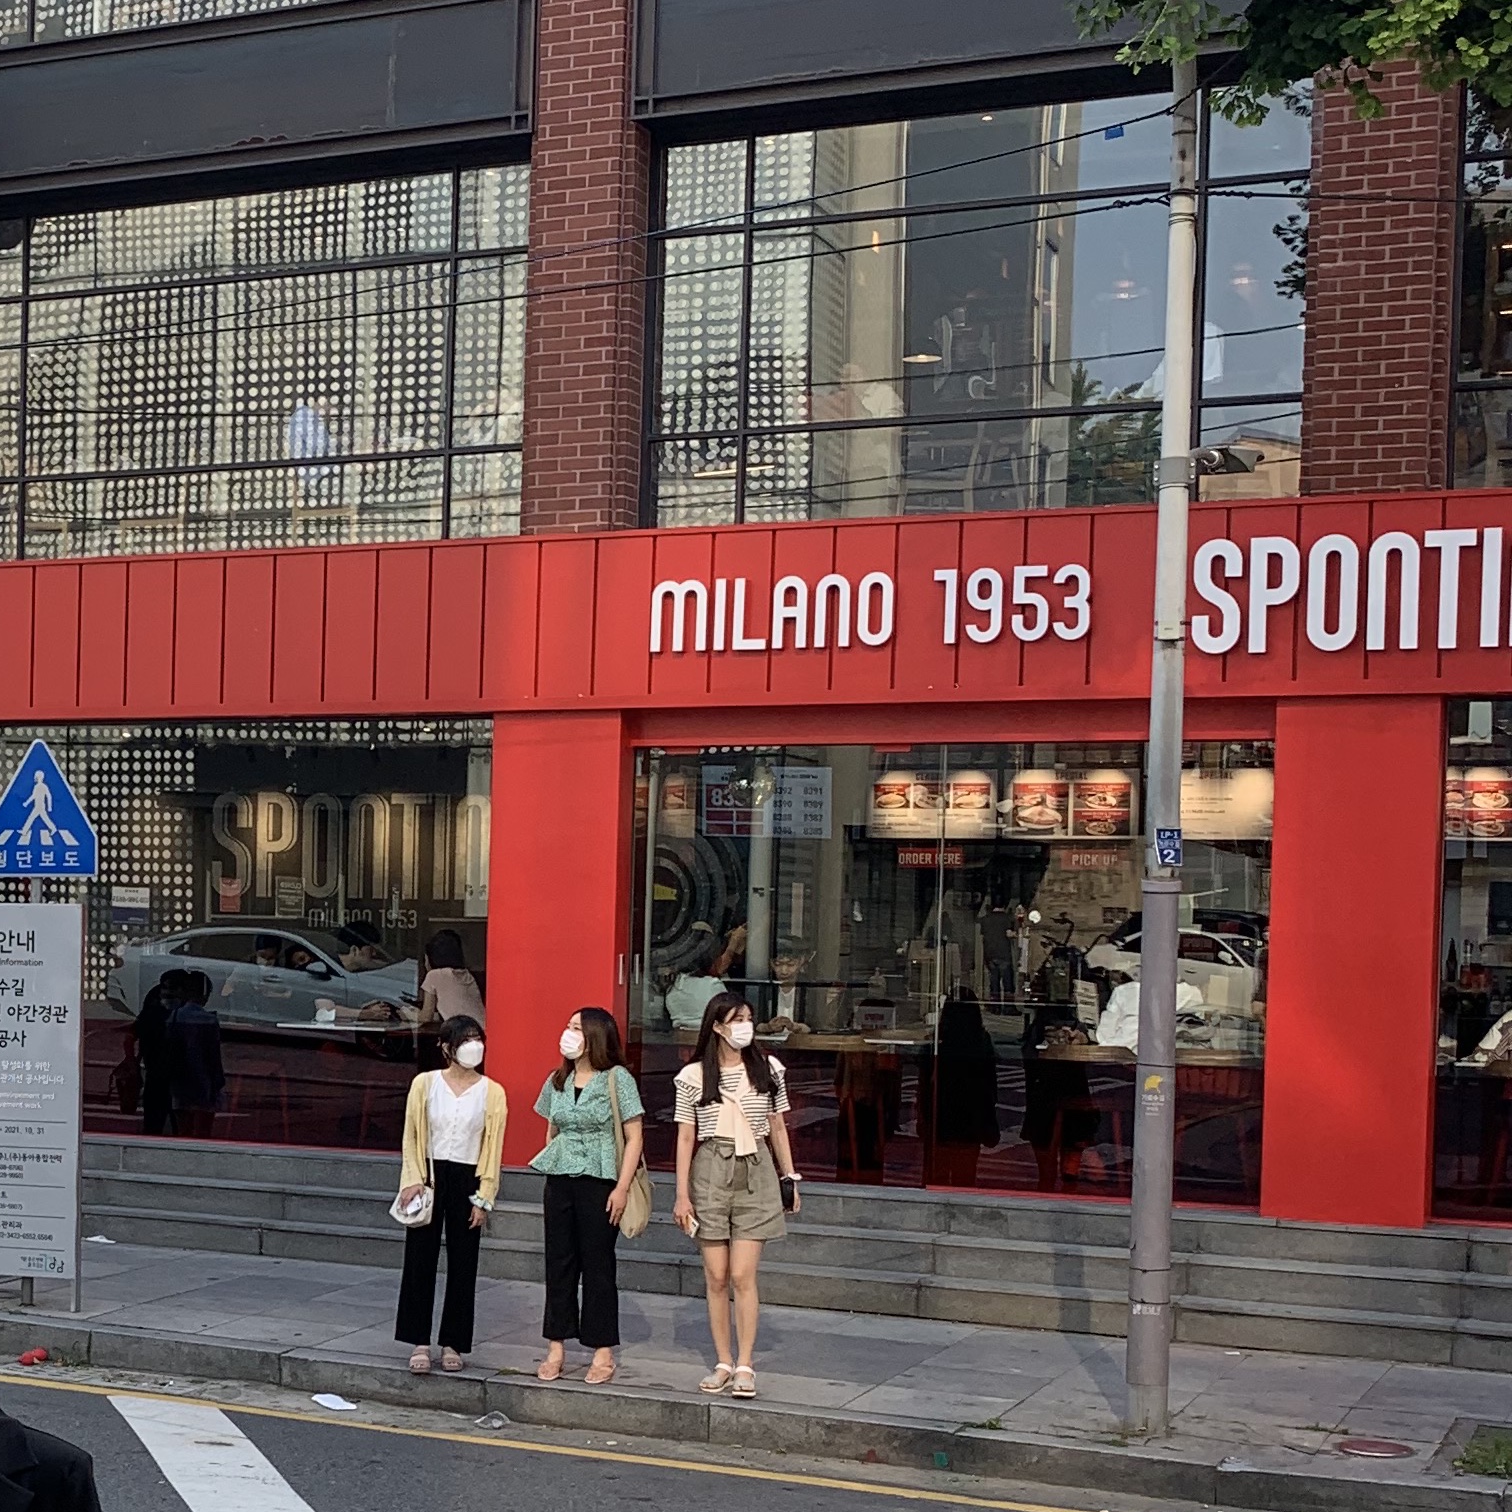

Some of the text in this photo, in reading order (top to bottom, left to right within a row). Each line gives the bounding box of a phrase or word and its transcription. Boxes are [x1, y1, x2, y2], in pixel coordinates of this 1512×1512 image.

[1191, 526, 1512, 655] SPONTI
[649, 563, 1092, 654] MILANO 1953
[1160, 830, 1179, 839] LP-1
[898, 853, 932, 866] ORDER
[1071, 854, 1119, 867] PICK UP
[1162, 848, 1176, 863] 2
[378, 908, 418, 930] 1953
[7, 1004, 69, 1024] 야간경관
[35, 1060, 51, 1072] 위한
